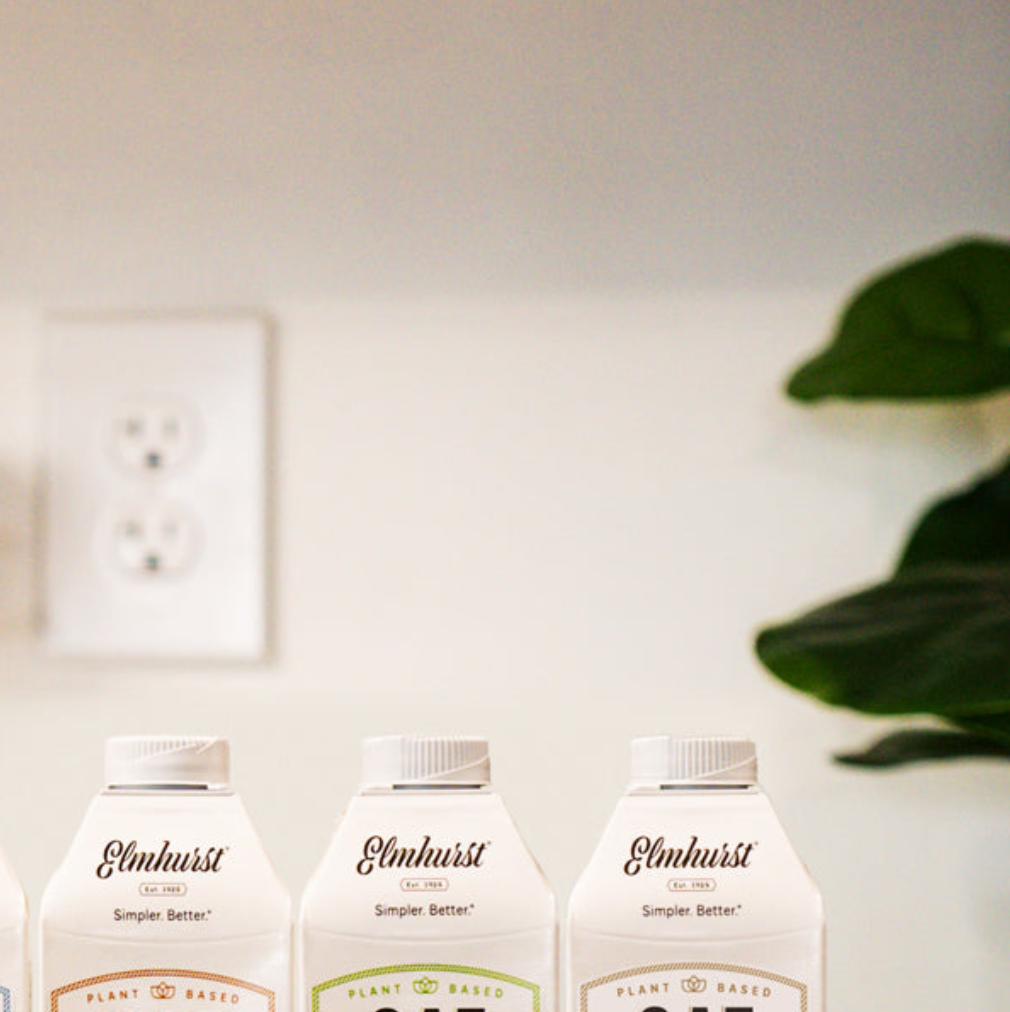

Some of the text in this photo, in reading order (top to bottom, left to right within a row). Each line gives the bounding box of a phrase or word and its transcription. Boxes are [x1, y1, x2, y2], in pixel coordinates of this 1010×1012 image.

[96, 840, 224, 879] Elmhurst
[357, 835, 486, 875] Elmhurst
[624, 836, 754, 876] Elmhurst
[114, 909, 163, 923] Simpler.
[375, 904, 425, 918] Simpler.
[643, 905, 693, 918] Simpler.
[87, 990, 239, 1004] PLANT BASED
[349, 984, 503, 999] PLANT BASED
[618, 983, 772, 998] PLANT BASED
